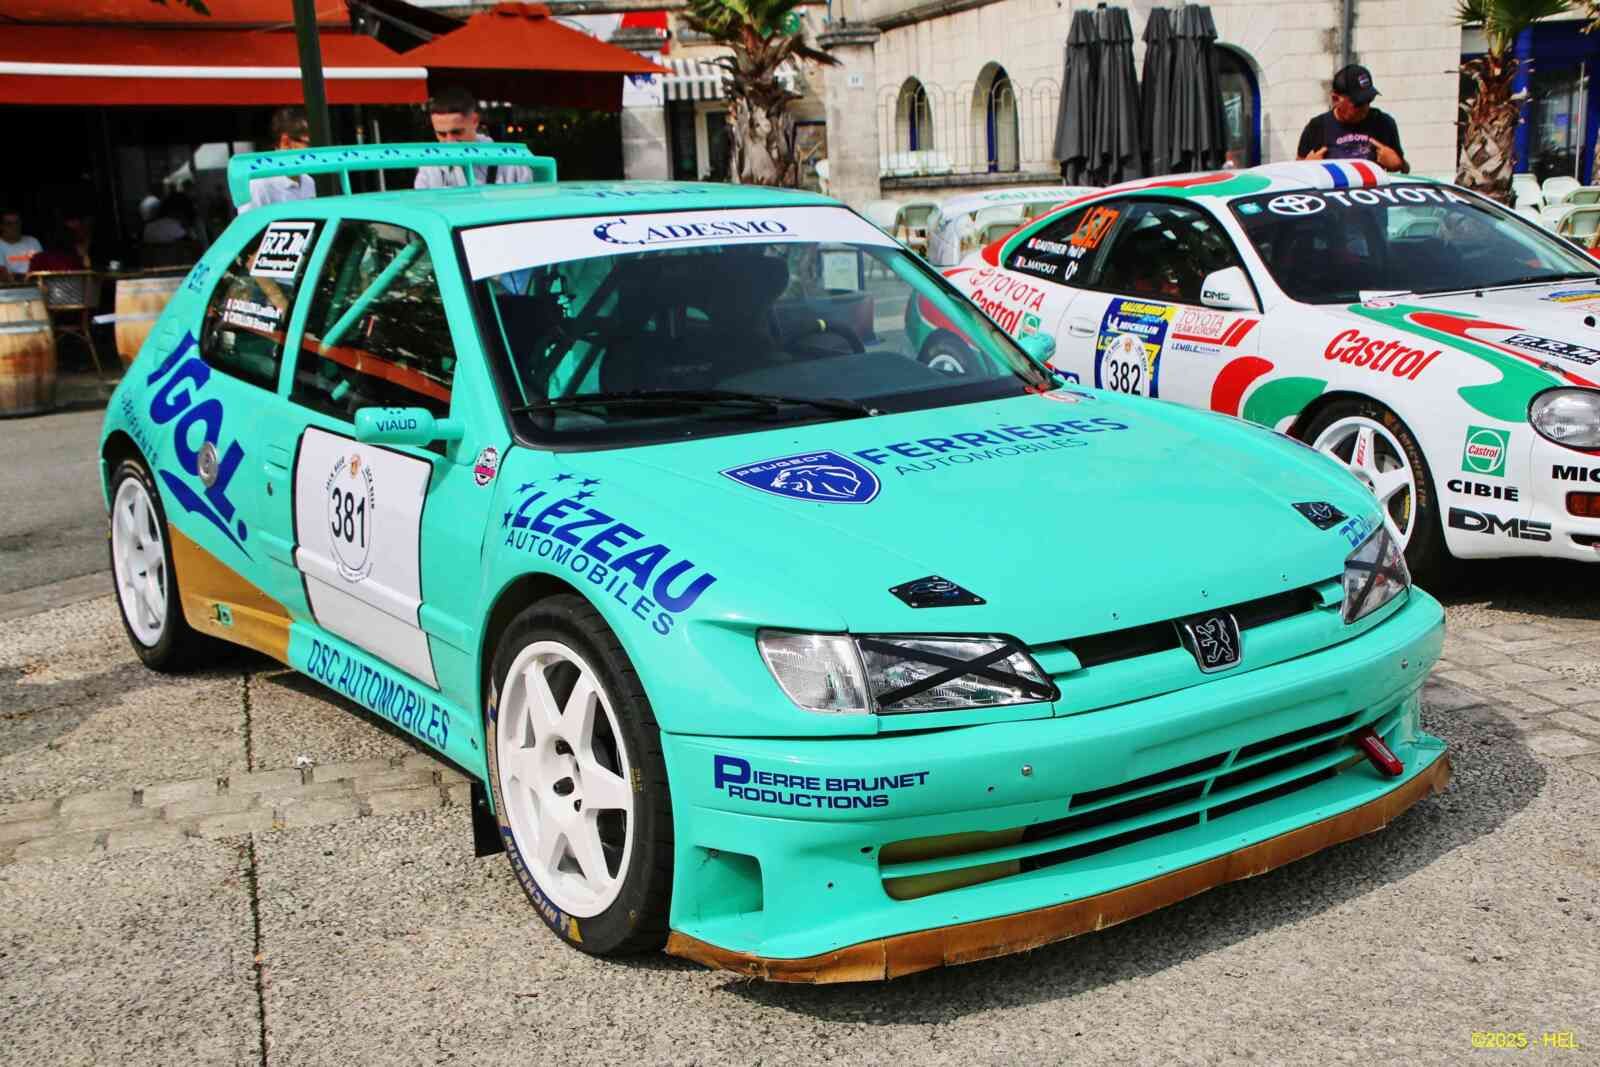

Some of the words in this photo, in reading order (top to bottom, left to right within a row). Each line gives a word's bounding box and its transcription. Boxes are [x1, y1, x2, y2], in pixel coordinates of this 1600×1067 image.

[1323, 187, 1471, 207] TOYOTA
[593, 218, 788, 246] CADESMO
[989, 273, 1046, 312] TOYOTA
[1183, 311, 1225, 329] TOYOTA
[1324, 329, 1442, 381] Castrol
[1109, 360, 1141, 396] 382
[376, 419, 417, 432] VIAUD
[856, 417, 1129, 465] FERRIÈRES
[735, 454, 830, 477] PEUGEOT
[895, 437, 1088, 476] AUTOMOBILES
[1468, 445, 1498, 460] Castrol
[332, 487, 365, 548] 381
[504, 530, 674, 636] AUTOMOBILES
[307, 639, 340, 684] DSC
[338, 656, 450, 750] AUTOMOBILES
[714, 755, 820, 790] PIERRE
[825, 771, 929, 792] BRUNET
